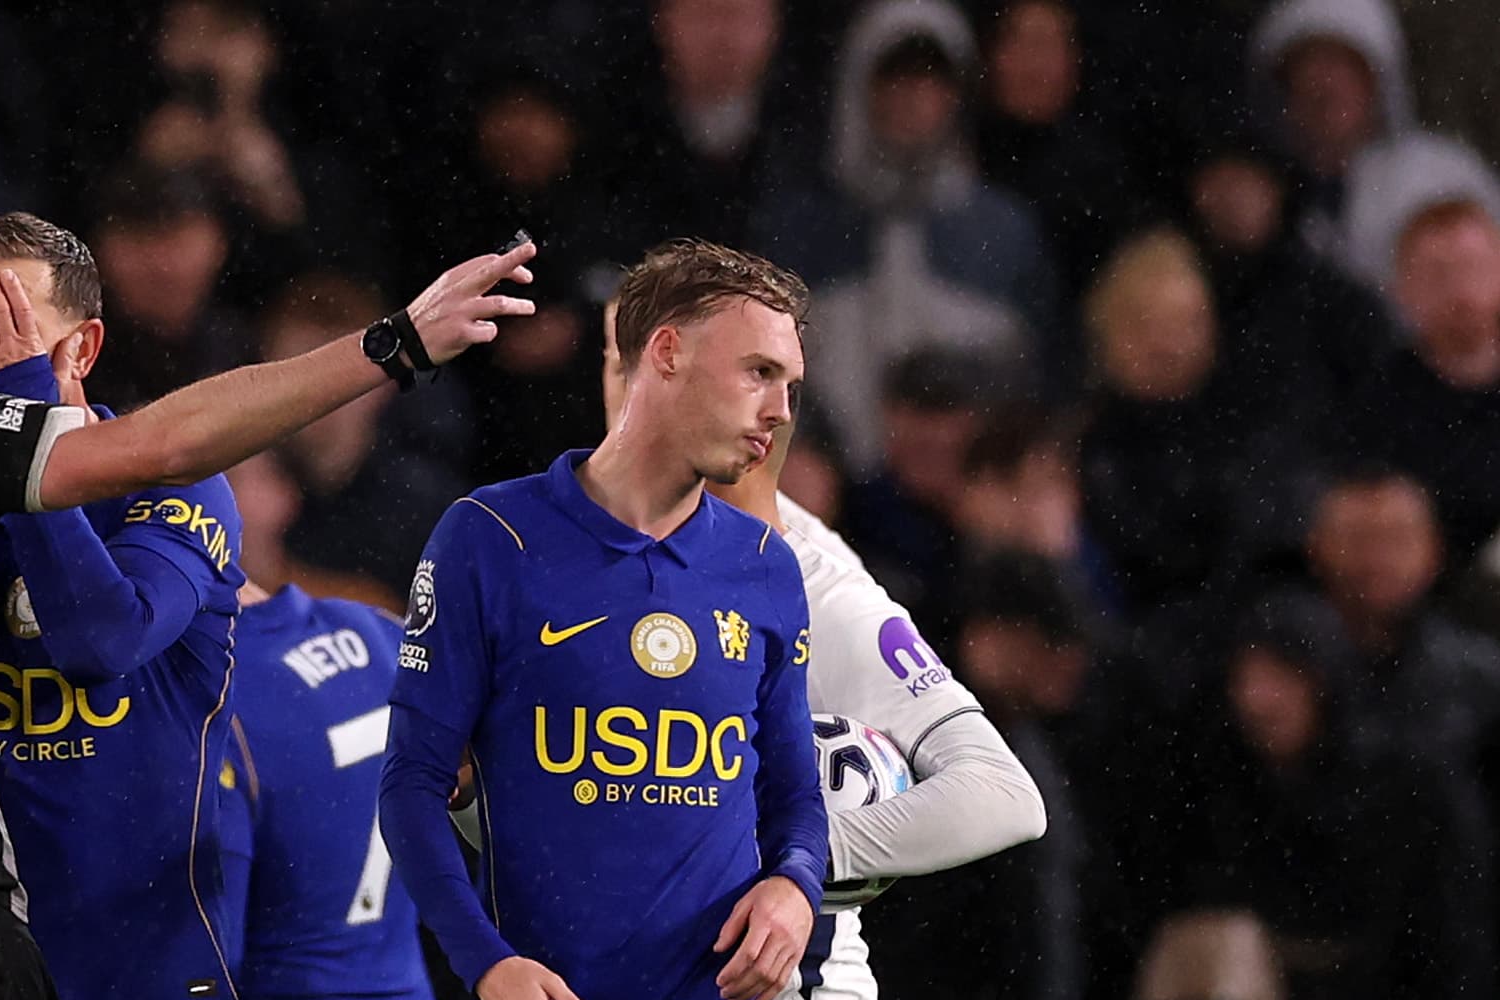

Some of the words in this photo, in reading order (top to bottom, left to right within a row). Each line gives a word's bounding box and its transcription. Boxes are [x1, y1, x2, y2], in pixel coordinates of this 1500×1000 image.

[124, 498, 231, 573] SOKIN
[283, 629, 370, 689] NETO
[650, 661, 677, 673] FIFA
[906, 666, 947, 698] kra
[12, 737, 96, 761] CIRCLE
[535, 705, 747, 781] USDC
[606, 783, 636, 802] BY
[642, 784, 719, 806] CIRCLE
